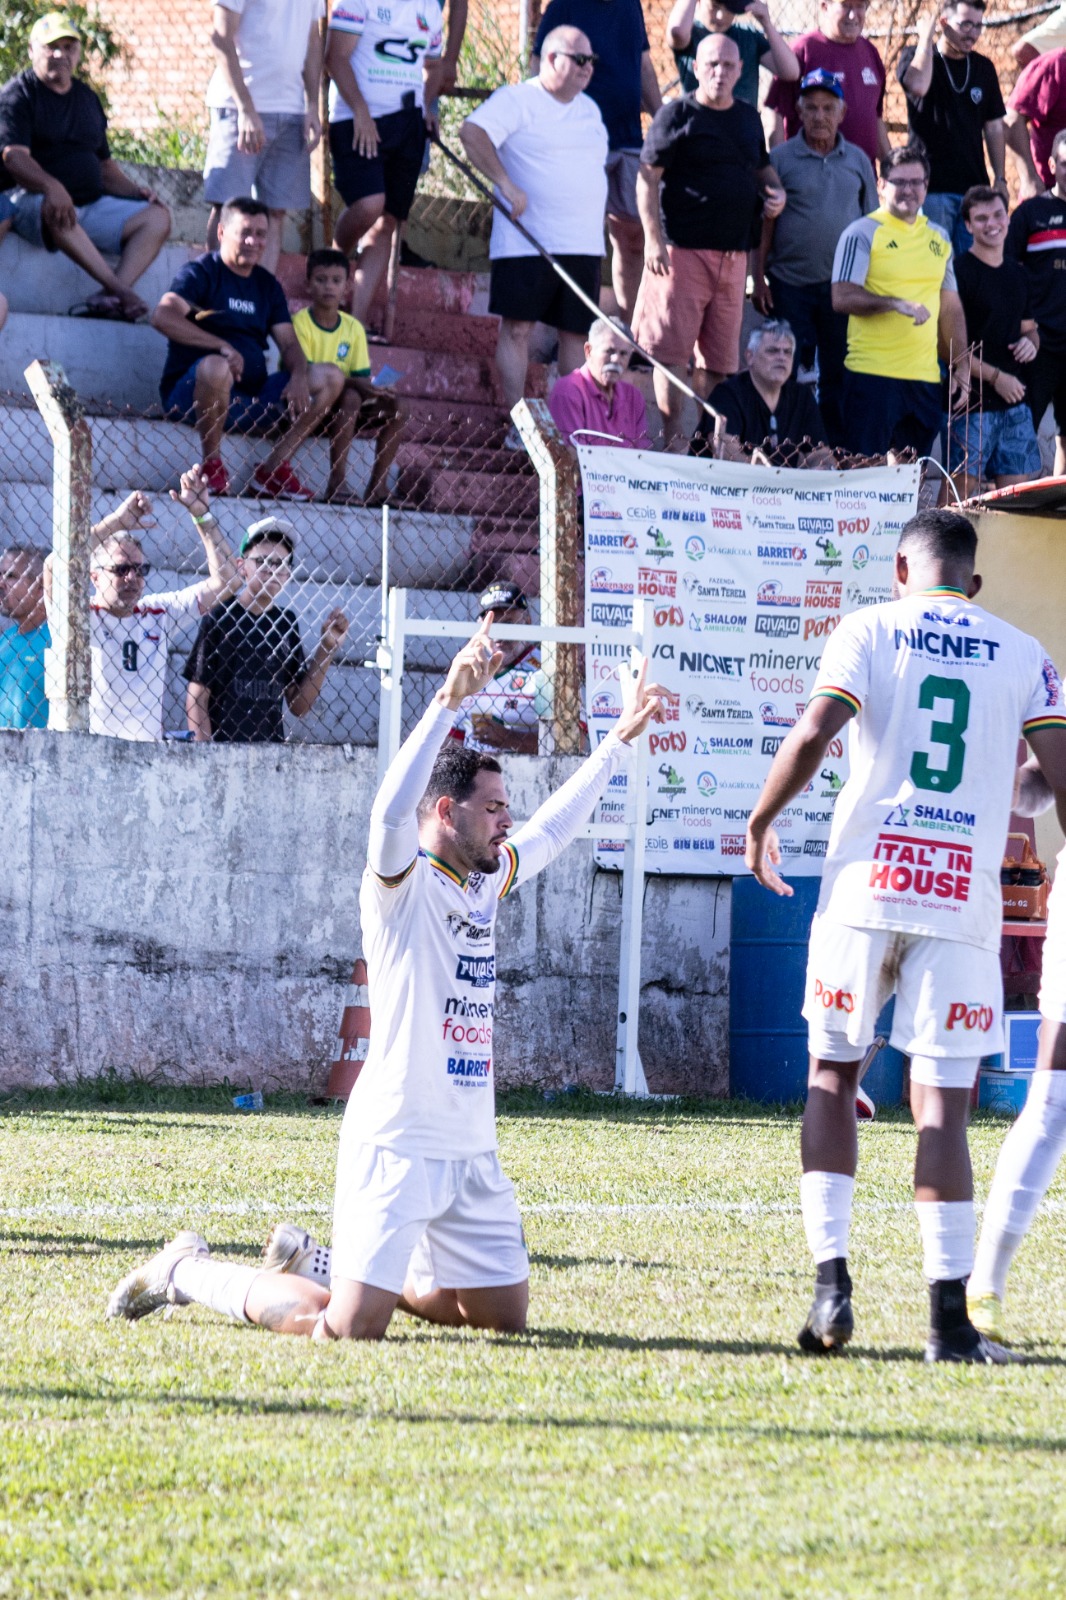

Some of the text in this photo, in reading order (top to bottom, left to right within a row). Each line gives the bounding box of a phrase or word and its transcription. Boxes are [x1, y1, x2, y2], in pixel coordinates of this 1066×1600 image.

[586, 471, 626, 484] minerva
[587, 481, 616, 495] foods
[628, 479, 669, 492] NICNET
[670, 478, 709, 492] minerva
[752, 485, 794, 496] minerva
[671, 489, 701, 502] foods
[710, 486, 749, 498] NICNET
[794, 491, 833, 502] NICNET
[834, 487, 877, 499] minerva
[879, 492, 915, 503] NICNET
[751, 495, 782, 506] foods
[835, 499, 867, 511] foods
[712, 519, 743, 530] HOUSE
[799, 519, 834, 532] RIVALO
[884, 521, 906, 530] SHALO
[665, 575, 677, 584] IN
[709, 577, 735, 585] FAZENDA
[637, 583, 677, 598] HOUSE
[697, 585, 746, 599] SANTA TEREZA
[832, 584, 842, 595] IN
[757, 592, 802, 606] Savegnago
[804, 596, 841, 608] HOUSE
[857, 594, 878, 605] SANTA
[653, 604, 685, 627] oty
[704, 613, 747, 625] SHALOM
[703, 625, 745, 633] AMBIENTAL
[757, 616, 799, 631] RIVALO
[894, 628, 1000, 661] NICNET
[122, 640, 138, 671] 9
[679, 652, 745, 677] NICNET
[749, 671, 804, 694] foods
[701, 707, 725, 719] SANTA
[909, 674, 971, 794] 3
[709, 737, 753, 748] SHALOM
[711, 748, 752, 756] AMBIENTAL
[601, 800, 625, 811] mine
[682, 804, 722, 815] minerva
[652, 808, 681, 819] CNET
[804, 811, 834, 822] NICNE
[913, 804, 976, 827] SHALOM
[683, 816, 712, 827] foods
[911, 820, 974, 836] AMBIENTAL
[721, 845, 746, 856] HOUS
[804, 841, 829, 853] RIVAL
[947, 852, 972, 874] IN
[869, 863, 971, 902] HOUSE
[921, 899, 962, 913] Gourmet
[442, 1017, 492, 1045] foods
